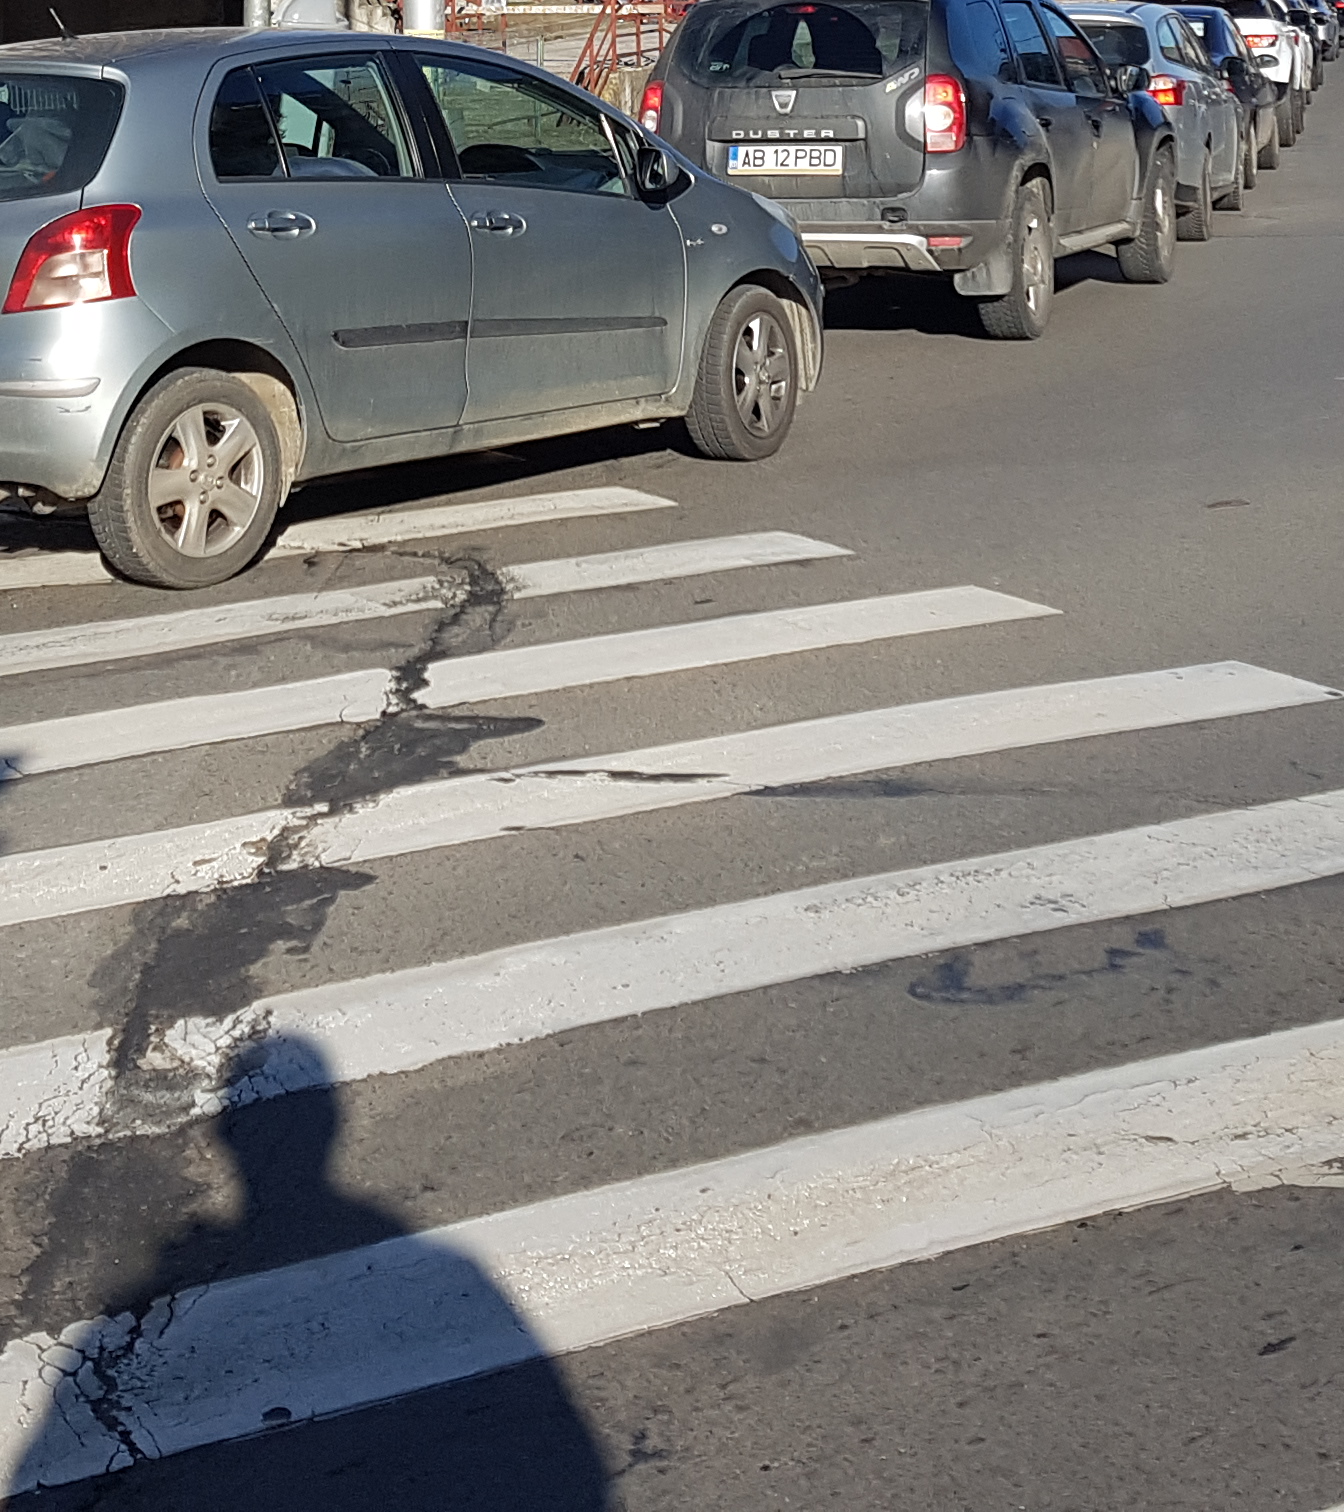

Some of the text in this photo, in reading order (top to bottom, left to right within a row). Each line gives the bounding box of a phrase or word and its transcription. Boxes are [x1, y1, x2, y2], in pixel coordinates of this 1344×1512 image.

[885, 67, 920, 93] 4WD
[732, 129, 834, 138] DUSTER
[741, 149, 765, 168] AB
